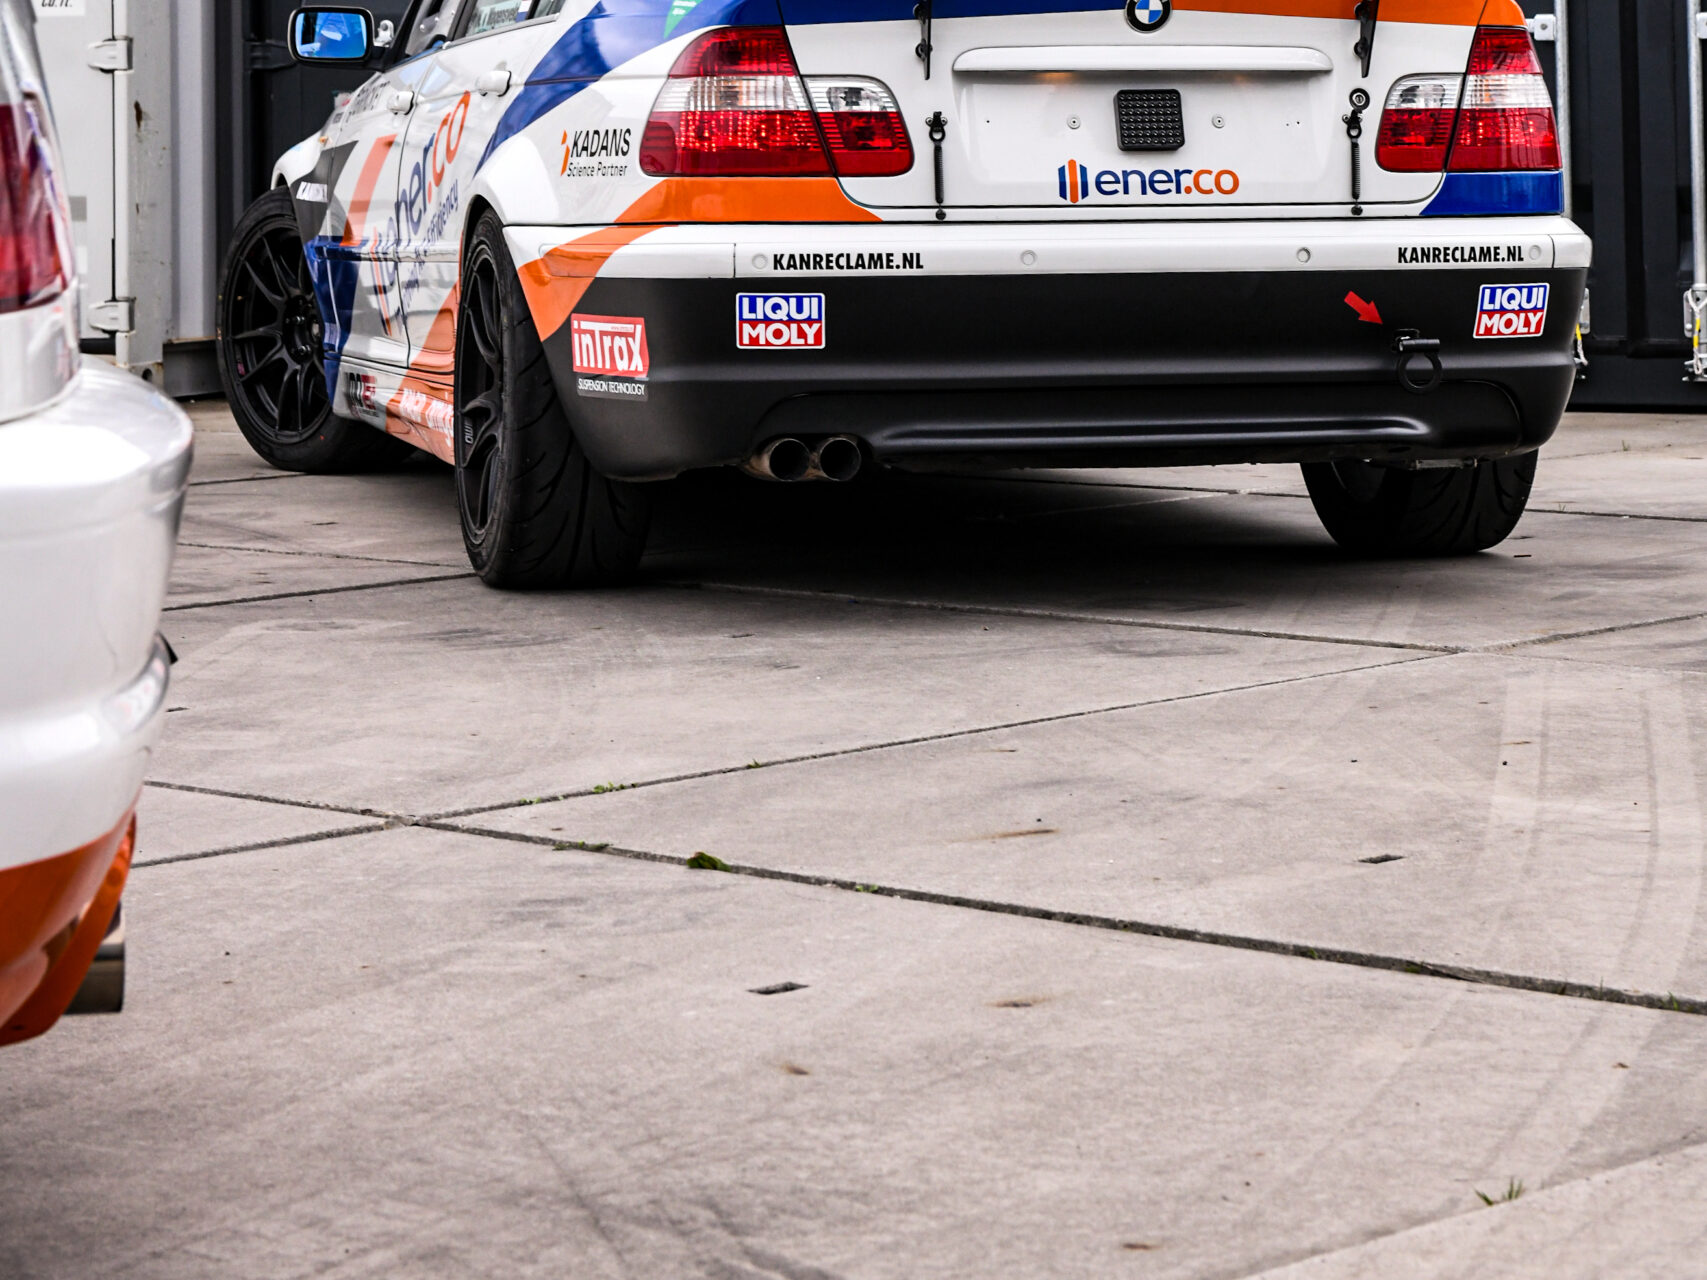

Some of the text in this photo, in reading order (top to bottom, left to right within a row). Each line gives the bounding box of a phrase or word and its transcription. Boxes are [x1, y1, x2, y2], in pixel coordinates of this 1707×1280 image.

[570, 128, 632, 158] KADANS
[567, 161, 628, 177] Science Partner
[1094, 169, 1240, 196] ener.co
[773, 252, 924, 270] KANRECLAME.NL
[1398, 246, 1524, 263] KANRECLAME.NL
[742, 296, 819, 321] LIQUI
[1482, 287, 1545, 311] LIQUI
[742, 322, 821, 345] MOLY
[1478, 311, 1544, 335] MOLY
[578, 378, 646, 396] SUSPENSION TECHNOLOGY
